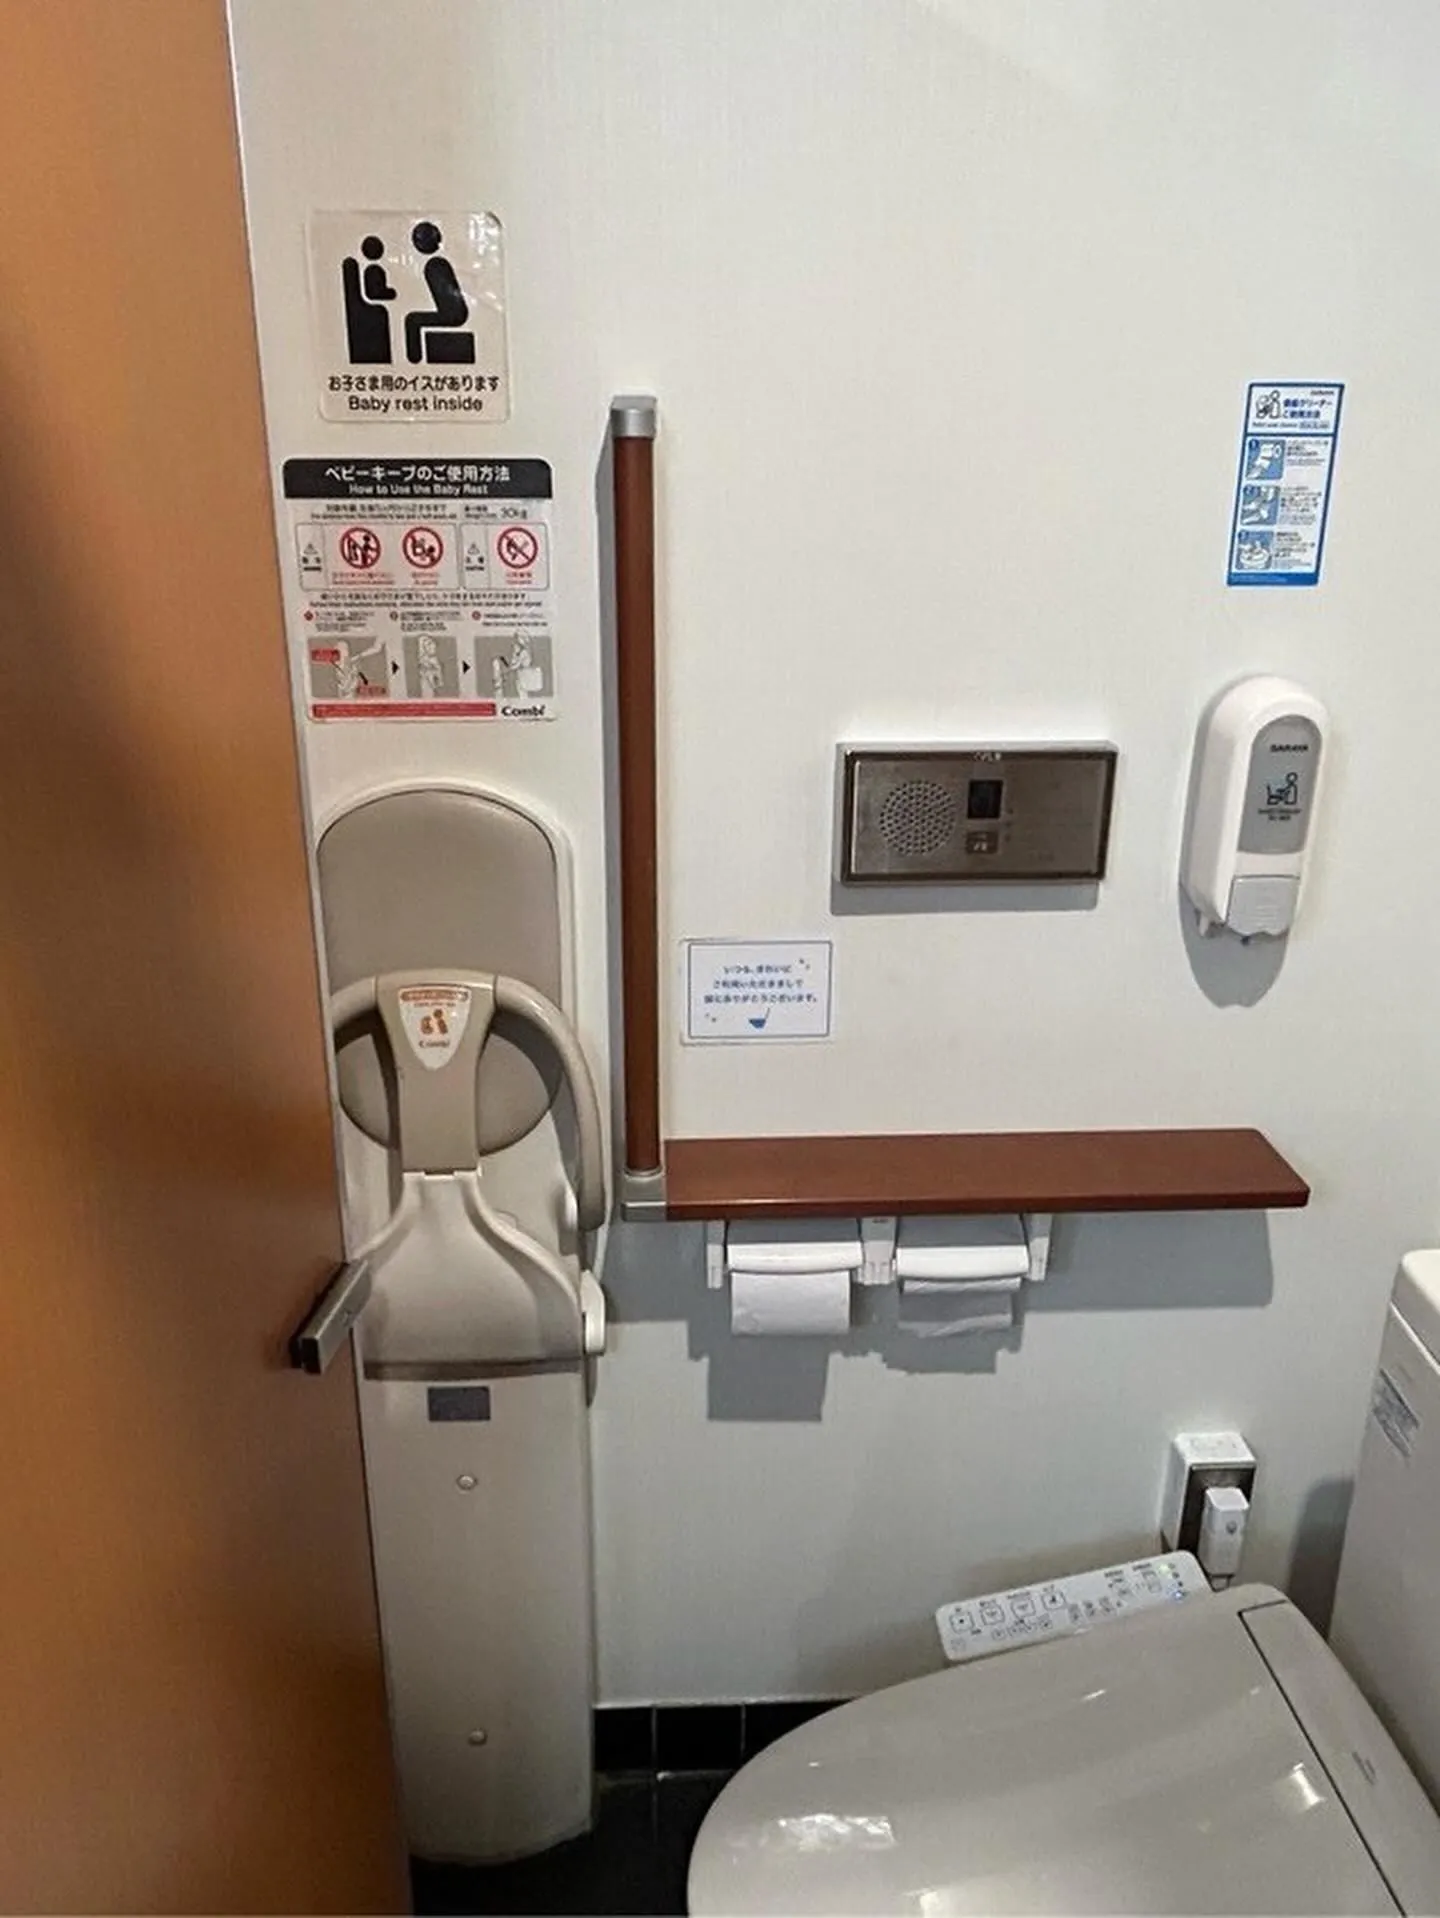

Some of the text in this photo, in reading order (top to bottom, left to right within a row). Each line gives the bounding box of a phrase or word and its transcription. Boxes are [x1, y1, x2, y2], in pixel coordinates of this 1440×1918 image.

[328, 375, 500, 392] お子さま用のイスがあります
[349, 395, 483, 413] Baby rest inside
[324, 464, 511, 482] ベビーキープのご使用方法
[348, 484, 489, 497] How to Use the Baby Rest
[501, 704, 545, 717] Combi
